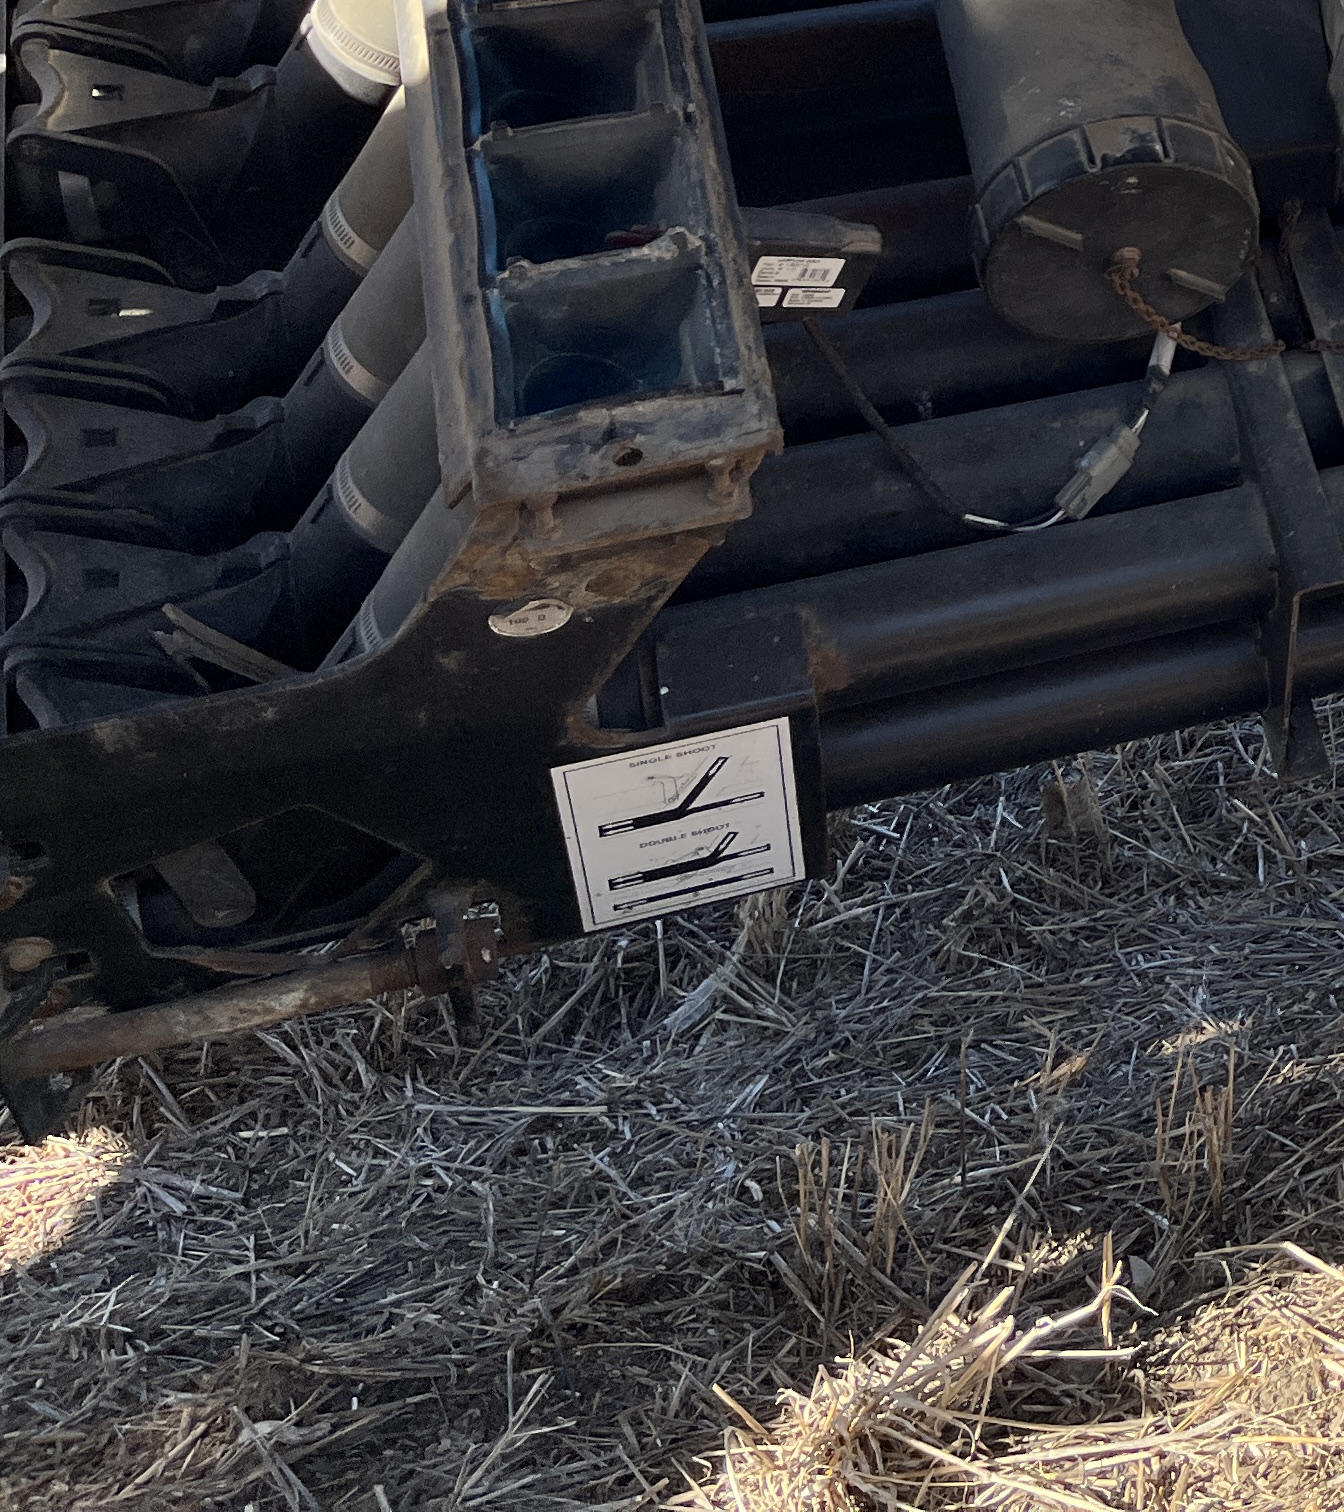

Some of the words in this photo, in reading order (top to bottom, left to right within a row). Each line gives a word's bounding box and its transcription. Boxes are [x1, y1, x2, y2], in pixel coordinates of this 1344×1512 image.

[629, 755, 672, 768] SINGLE
[676, 744, 716, 757] SHOOT
[639, 833, 687, 849] DOUBLE
[691, 823, 730, 836] SHOOT
